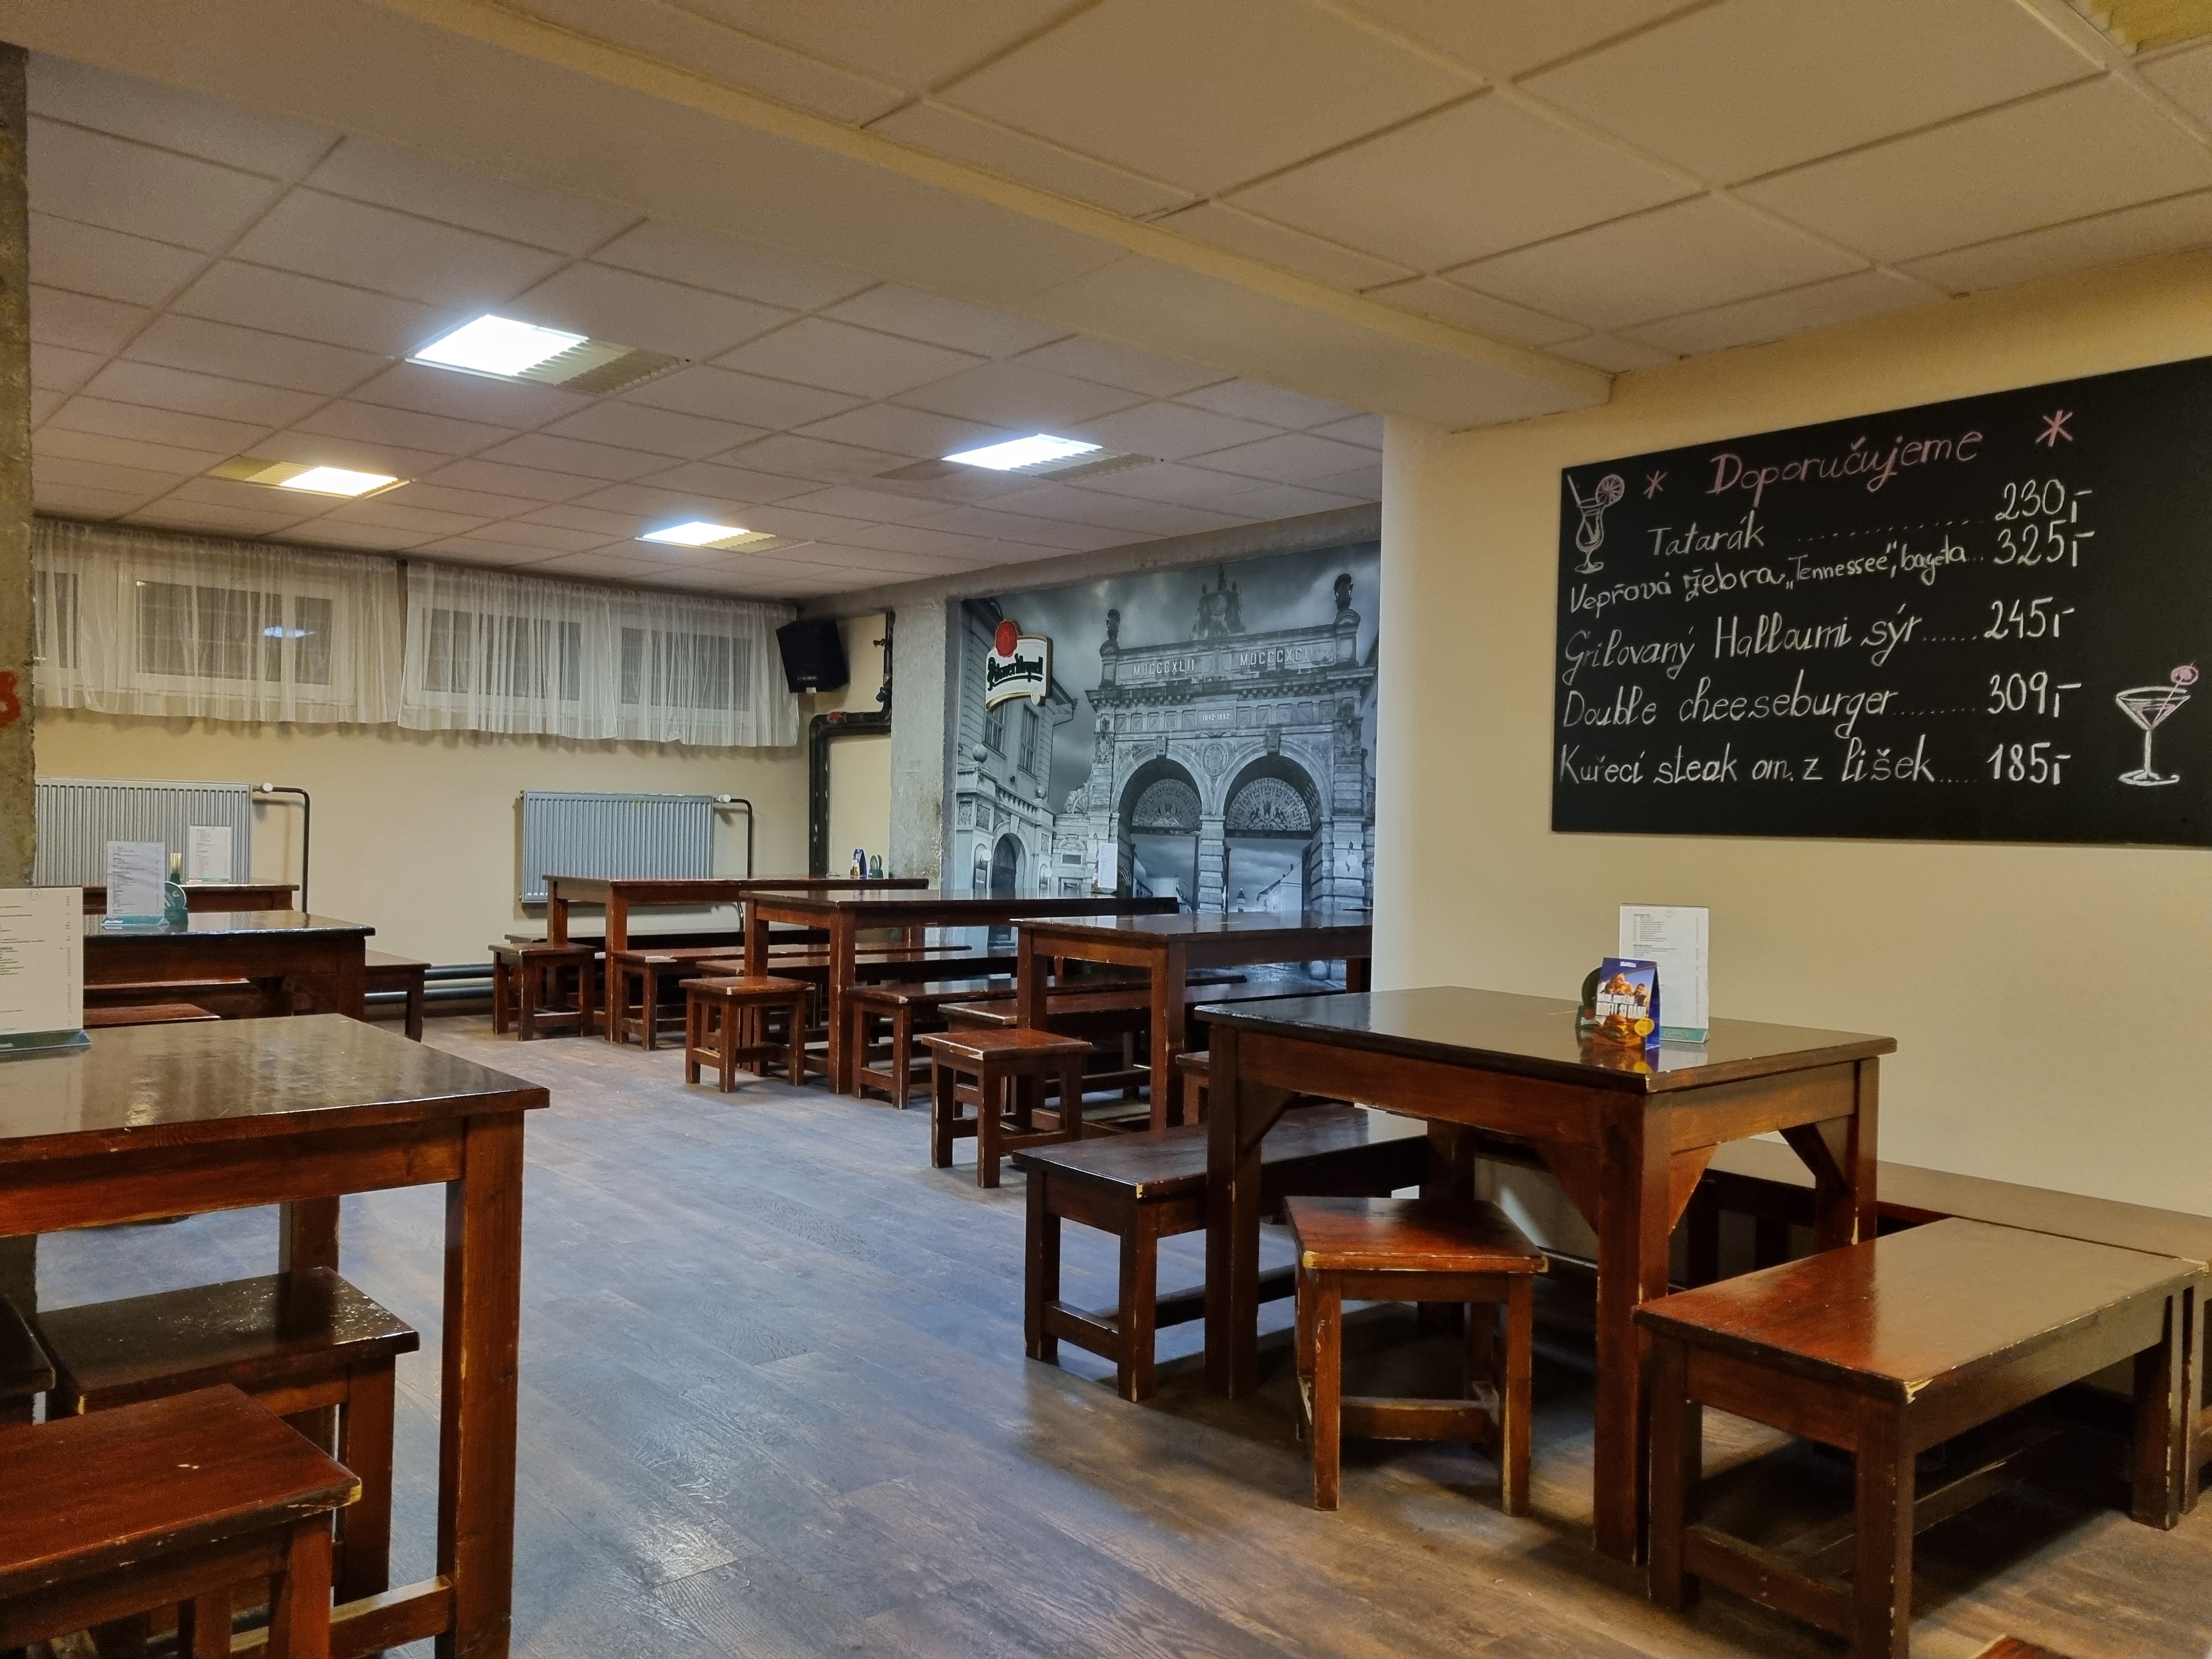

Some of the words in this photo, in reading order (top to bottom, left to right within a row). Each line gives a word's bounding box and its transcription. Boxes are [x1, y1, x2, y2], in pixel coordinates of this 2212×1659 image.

[1705, 430, 1983, 509] Doporučujeme
[1647, 510, 1765, 556] Tatarák
[1571, 571, 1672, 619] Vepřová
[1900, 534, 1970, 586] bageta
[1562, 626, 1695, 686] Grilovaný
[1714, 611, 1853, 659] Halloumi
[1859, 602, 1923, 667] sýr
[1563, 685, 1657, 727] Double
[1679, 668, 1899, 740] cheeseburger
[1560, 743, 1646, 785] Kuřecí
[1652, 742, 1738, 785] steak
[1802, 757, 1824, 781] z
[1840, 734, 1936, 783] lišek
